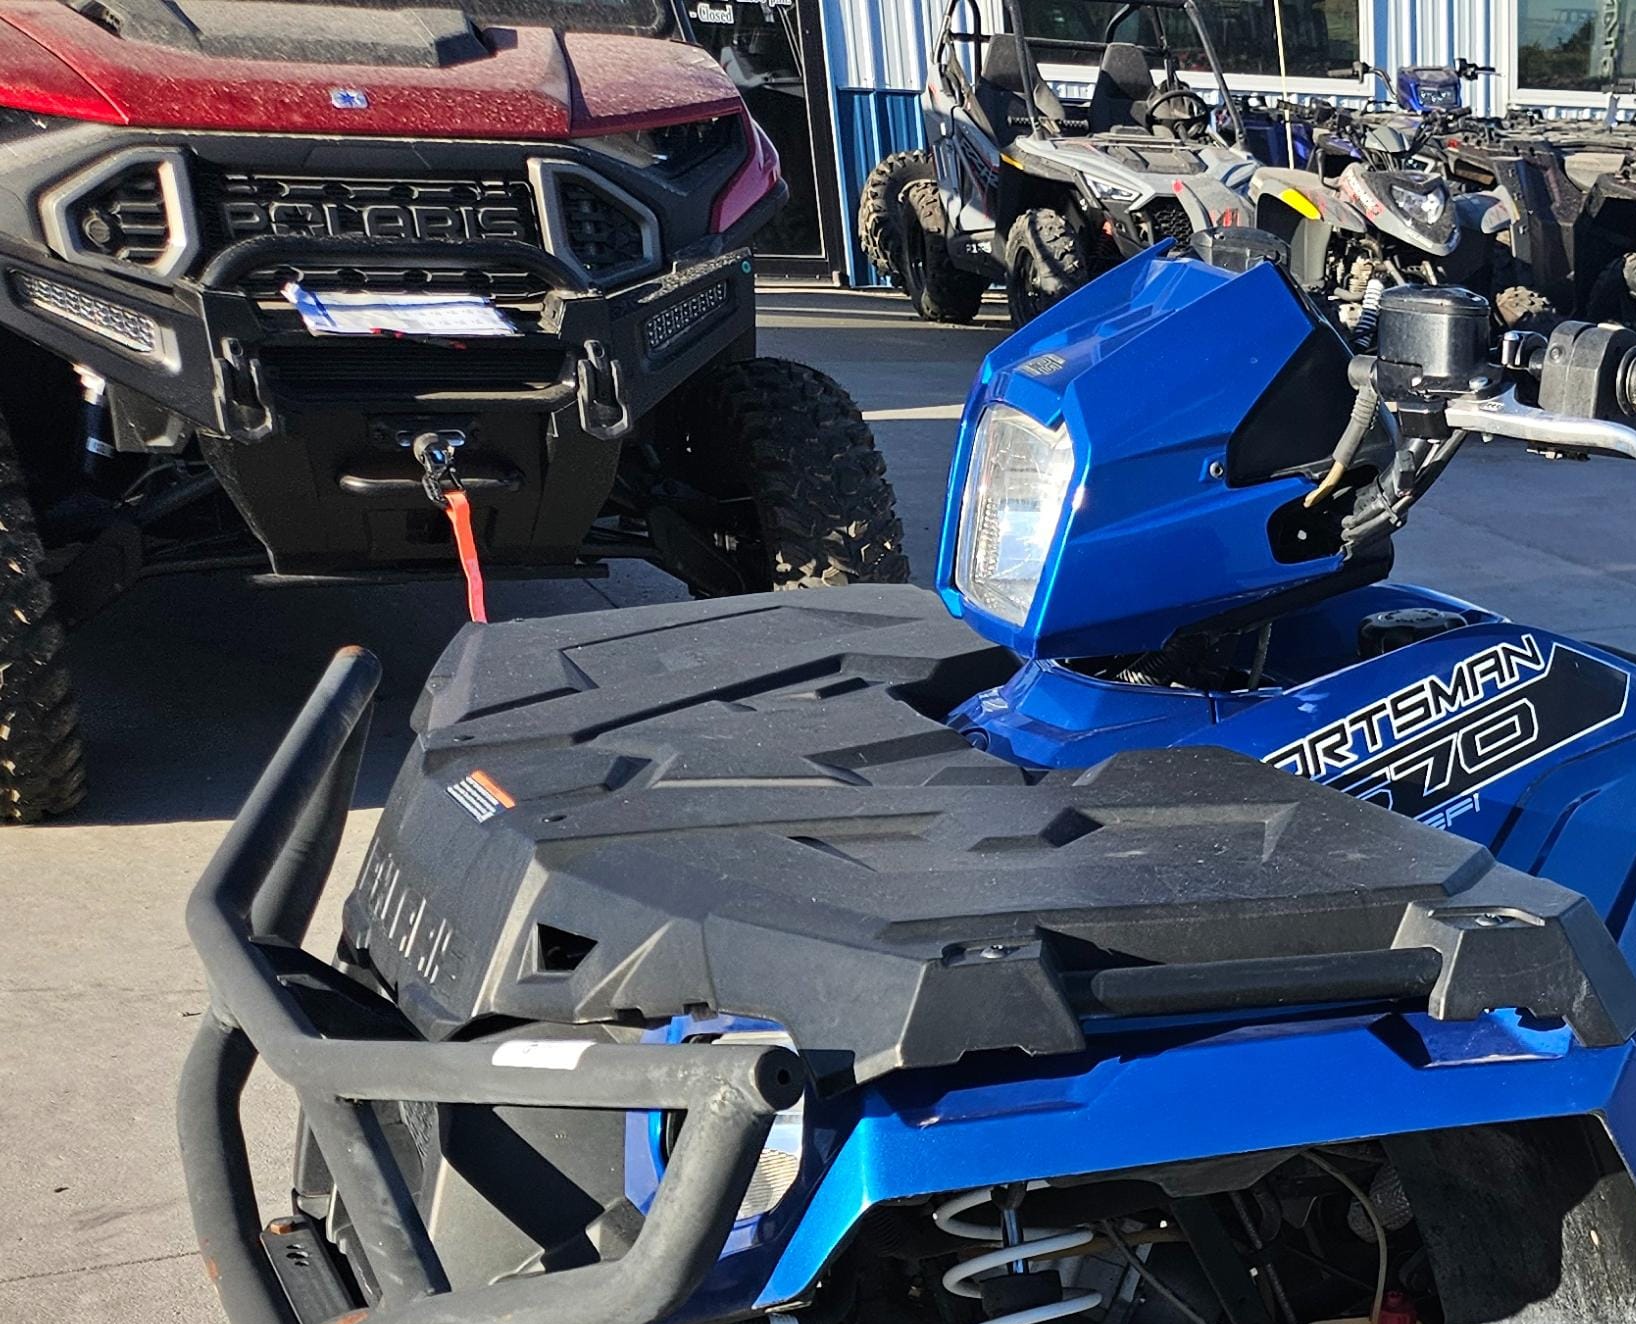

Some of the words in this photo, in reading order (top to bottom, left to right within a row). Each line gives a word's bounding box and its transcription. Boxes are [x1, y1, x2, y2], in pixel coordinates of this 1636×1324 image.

[697, 3, 734, 24] Closed
[223, 199, 527, 240] POLARIS
[1259, 633, 1546, 780] ORTSMAN
